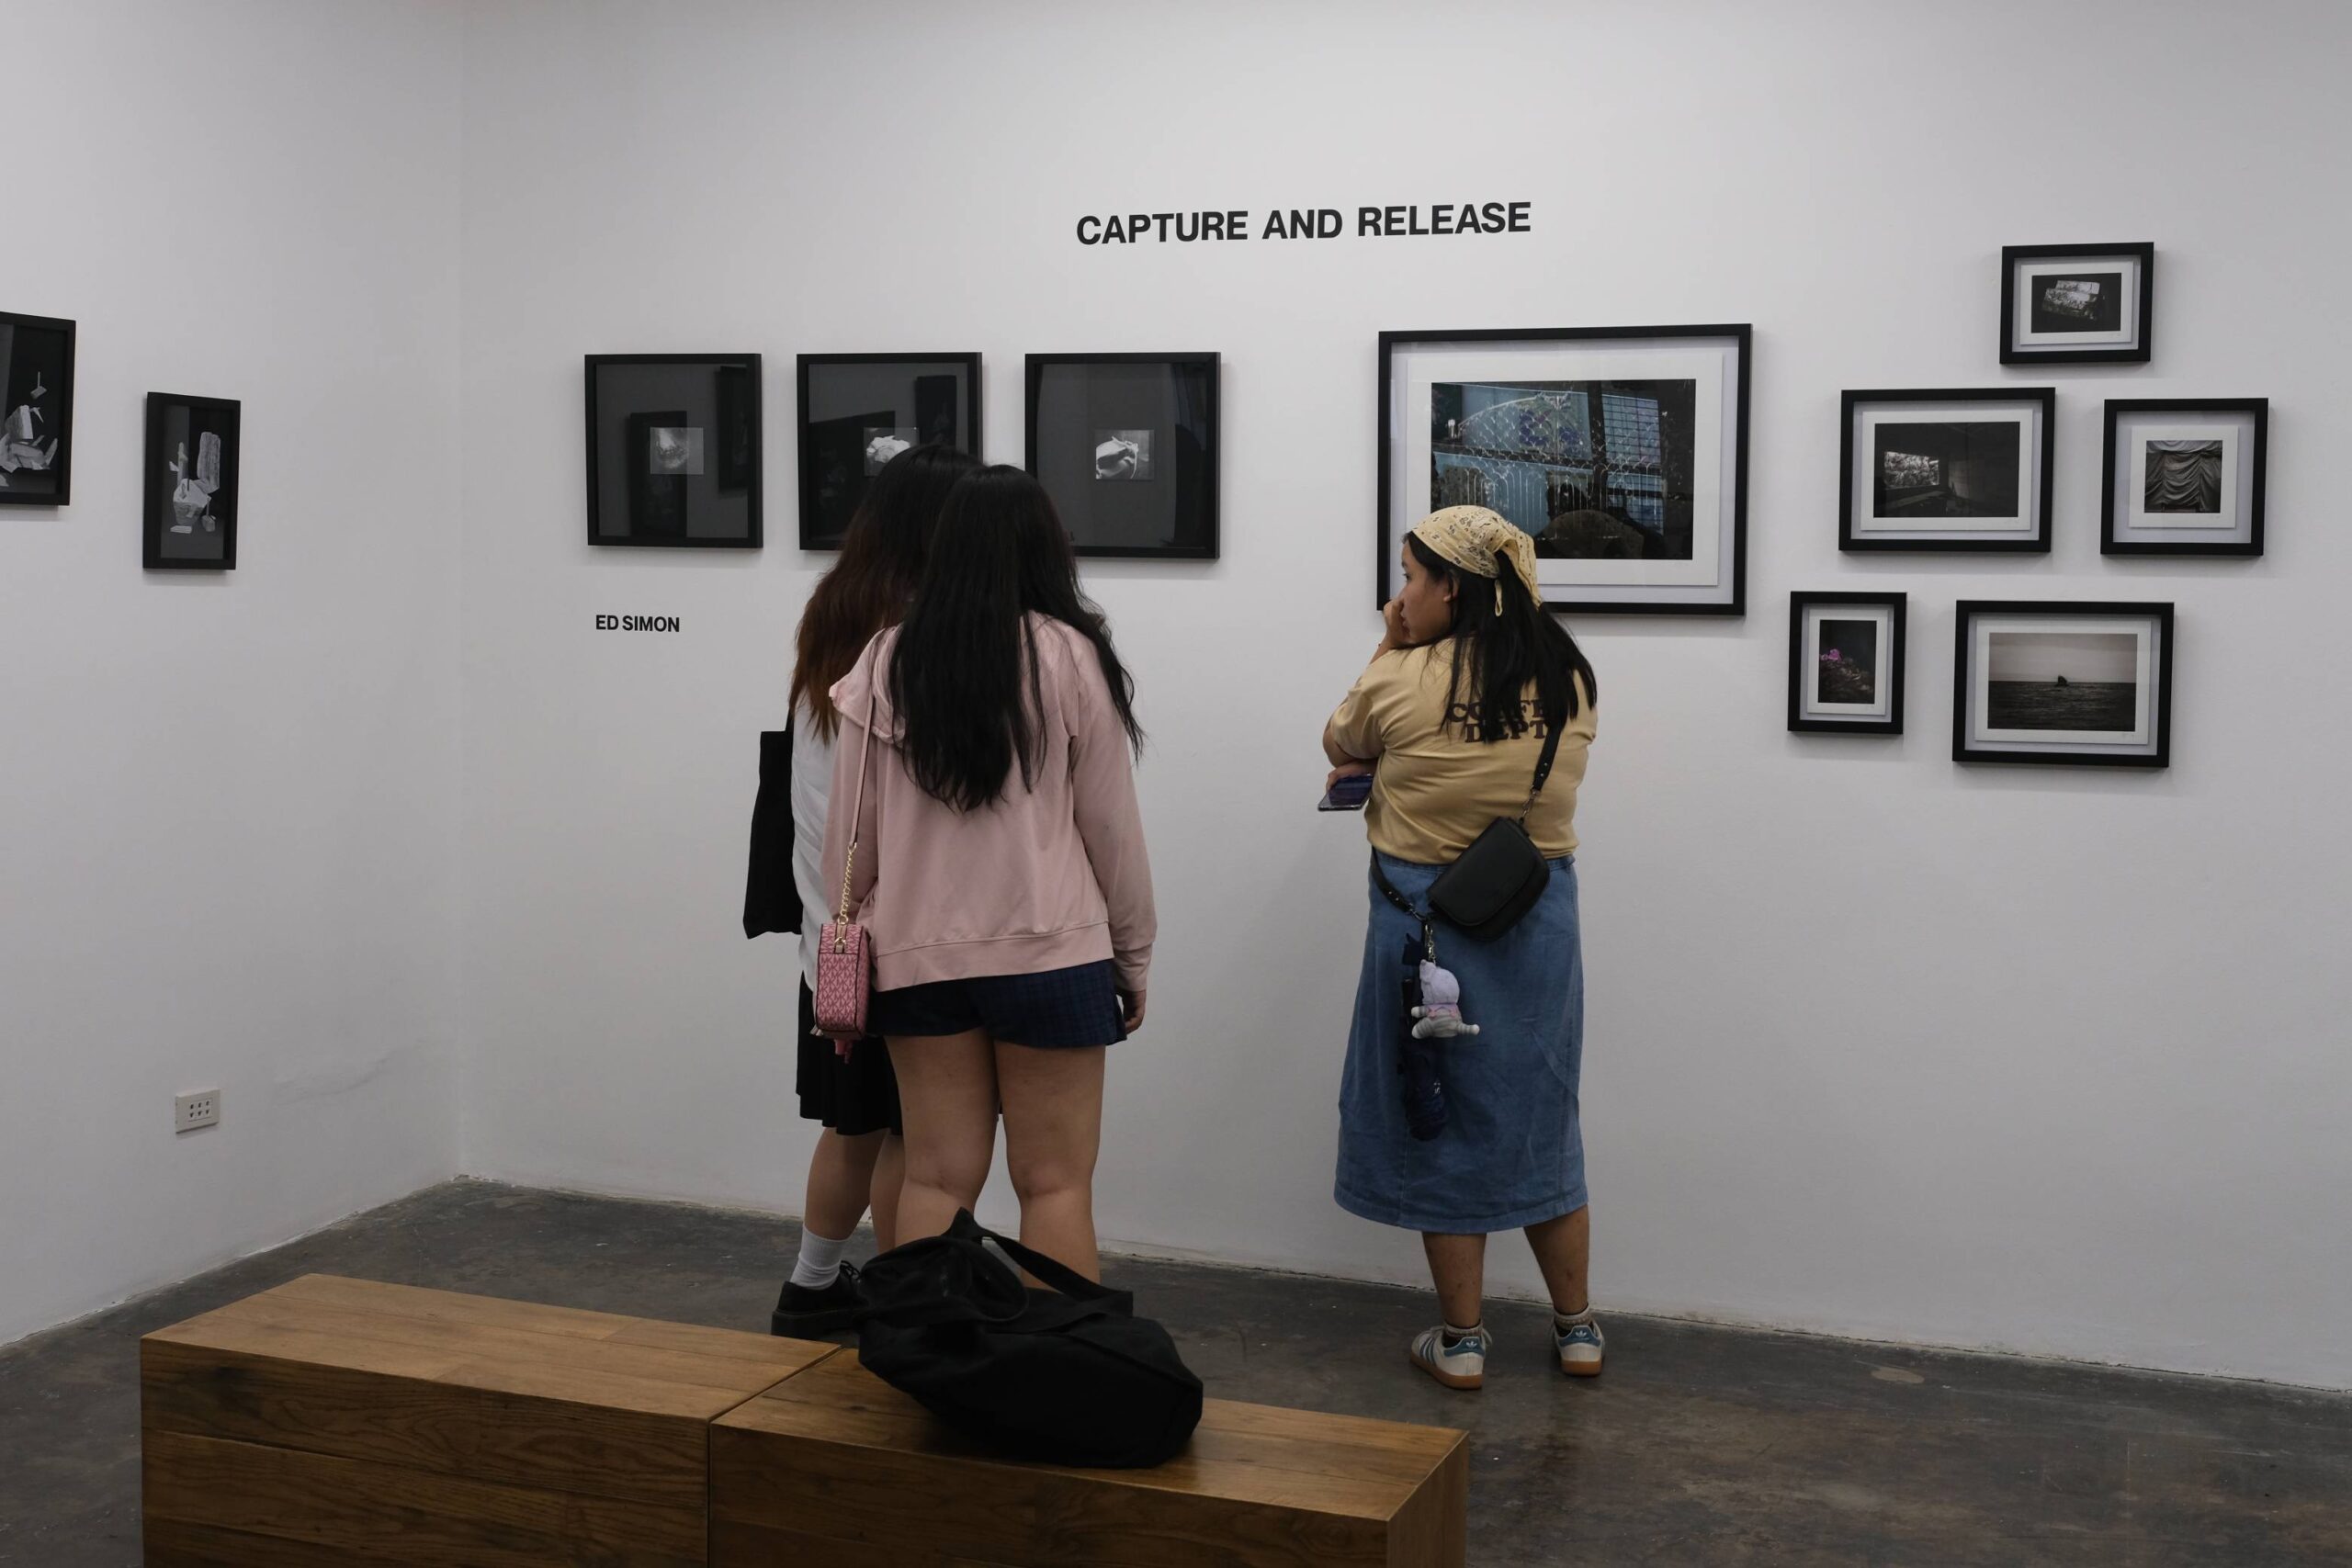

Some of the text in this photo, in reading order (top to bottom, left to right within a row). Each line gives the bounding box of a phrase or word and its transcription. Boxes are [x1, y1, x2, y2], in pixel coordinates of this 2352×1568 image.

[1076, 201, 1532, 245] CAPTURE AND RELEASE
[595, 615, 680, 633] ED SIMON
